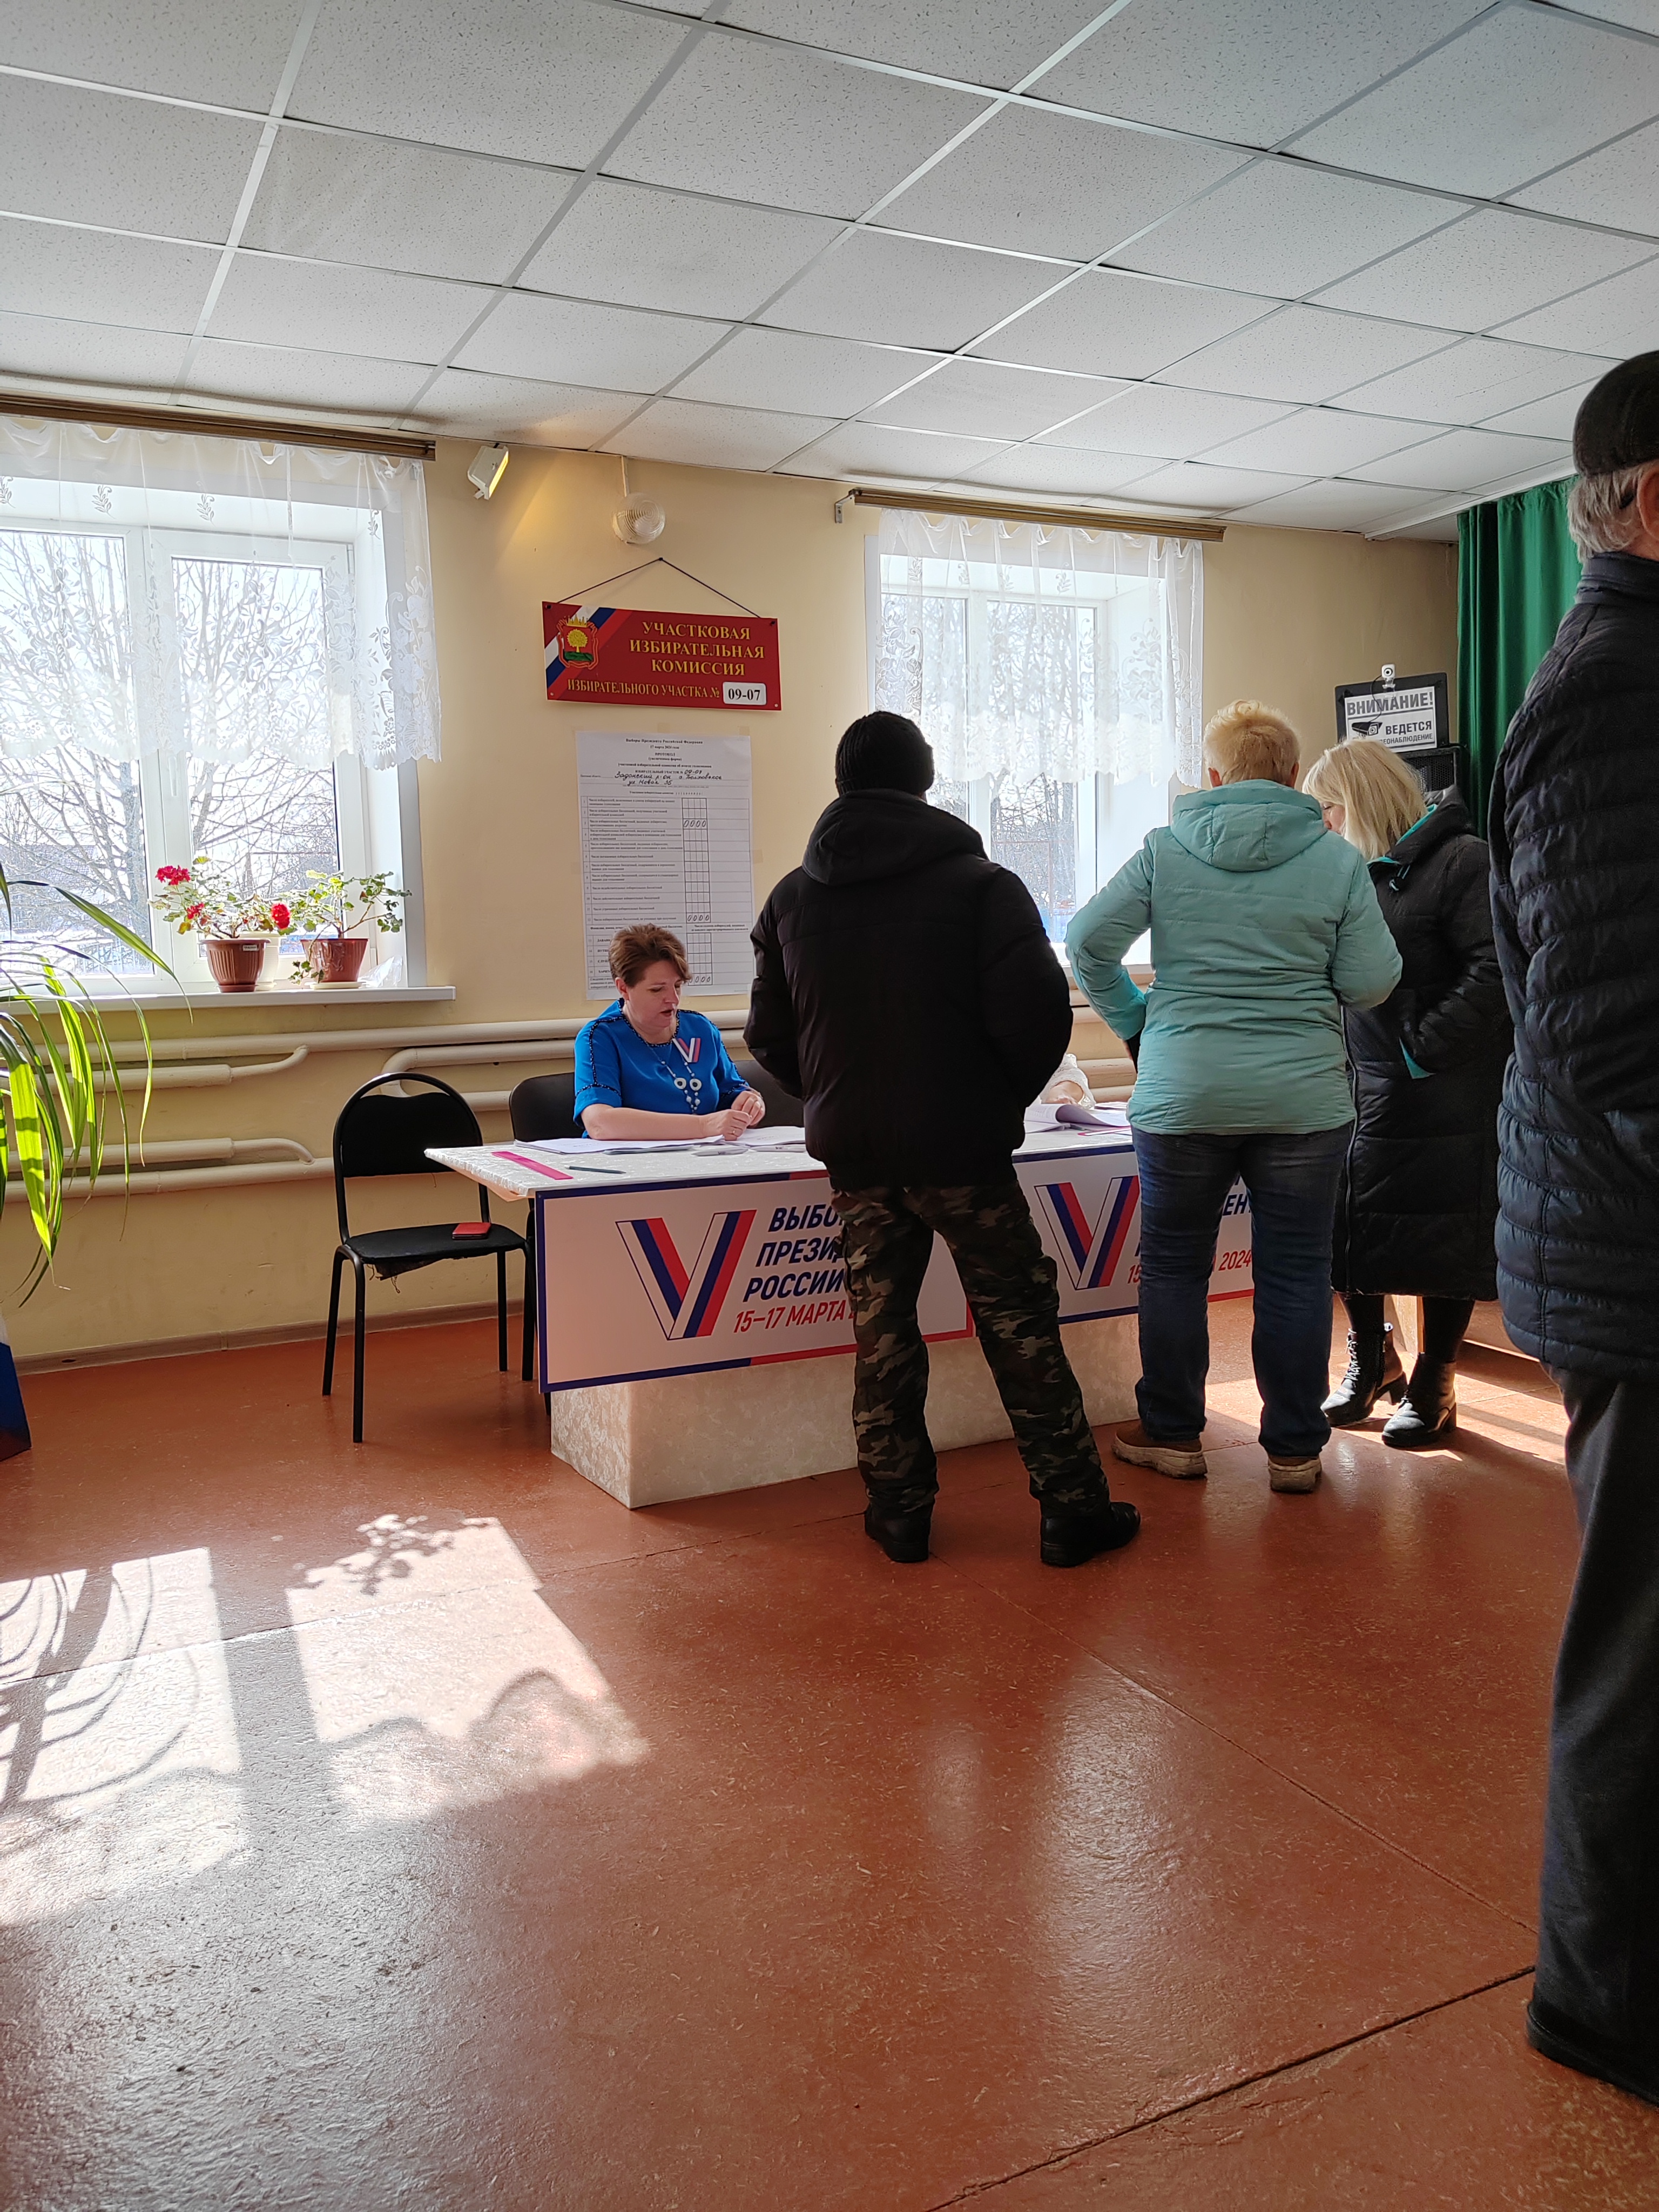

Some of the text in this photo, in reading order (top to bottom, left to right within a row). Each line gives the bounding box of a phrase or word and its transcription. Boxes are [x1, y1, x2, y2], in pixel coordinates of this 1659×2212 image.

[642, 622, 751, 640] УЧАСТКОВАЯ
[630, 639, 764, 658] ИЗБИРАТЕЛЬНАЯ
[651, 659, 745, 676] КОМИССИЯ
[568, 679, 760, 701] ИЗБИРАТЕЛЬНОГО УЧАСТКА № 09-07
[1347, 692, 1433, 716] ВНИМАНИЕ!
[1380, 733, 1433, 745] ЕОНАБЛЮДЕНИЕ
[1386, 720, 1432, 736] ВЕДЕТСЯ
[767, 1204, 842, 1232] ВЫБО
[755, 1237, 844, 1267] ПРЕЗИ
[1218, 1249, 1251, 1271] 2024
[743, 1268, 845, 1303] РОССИИ
[785, 1299, 846, 1327] МАРТА
